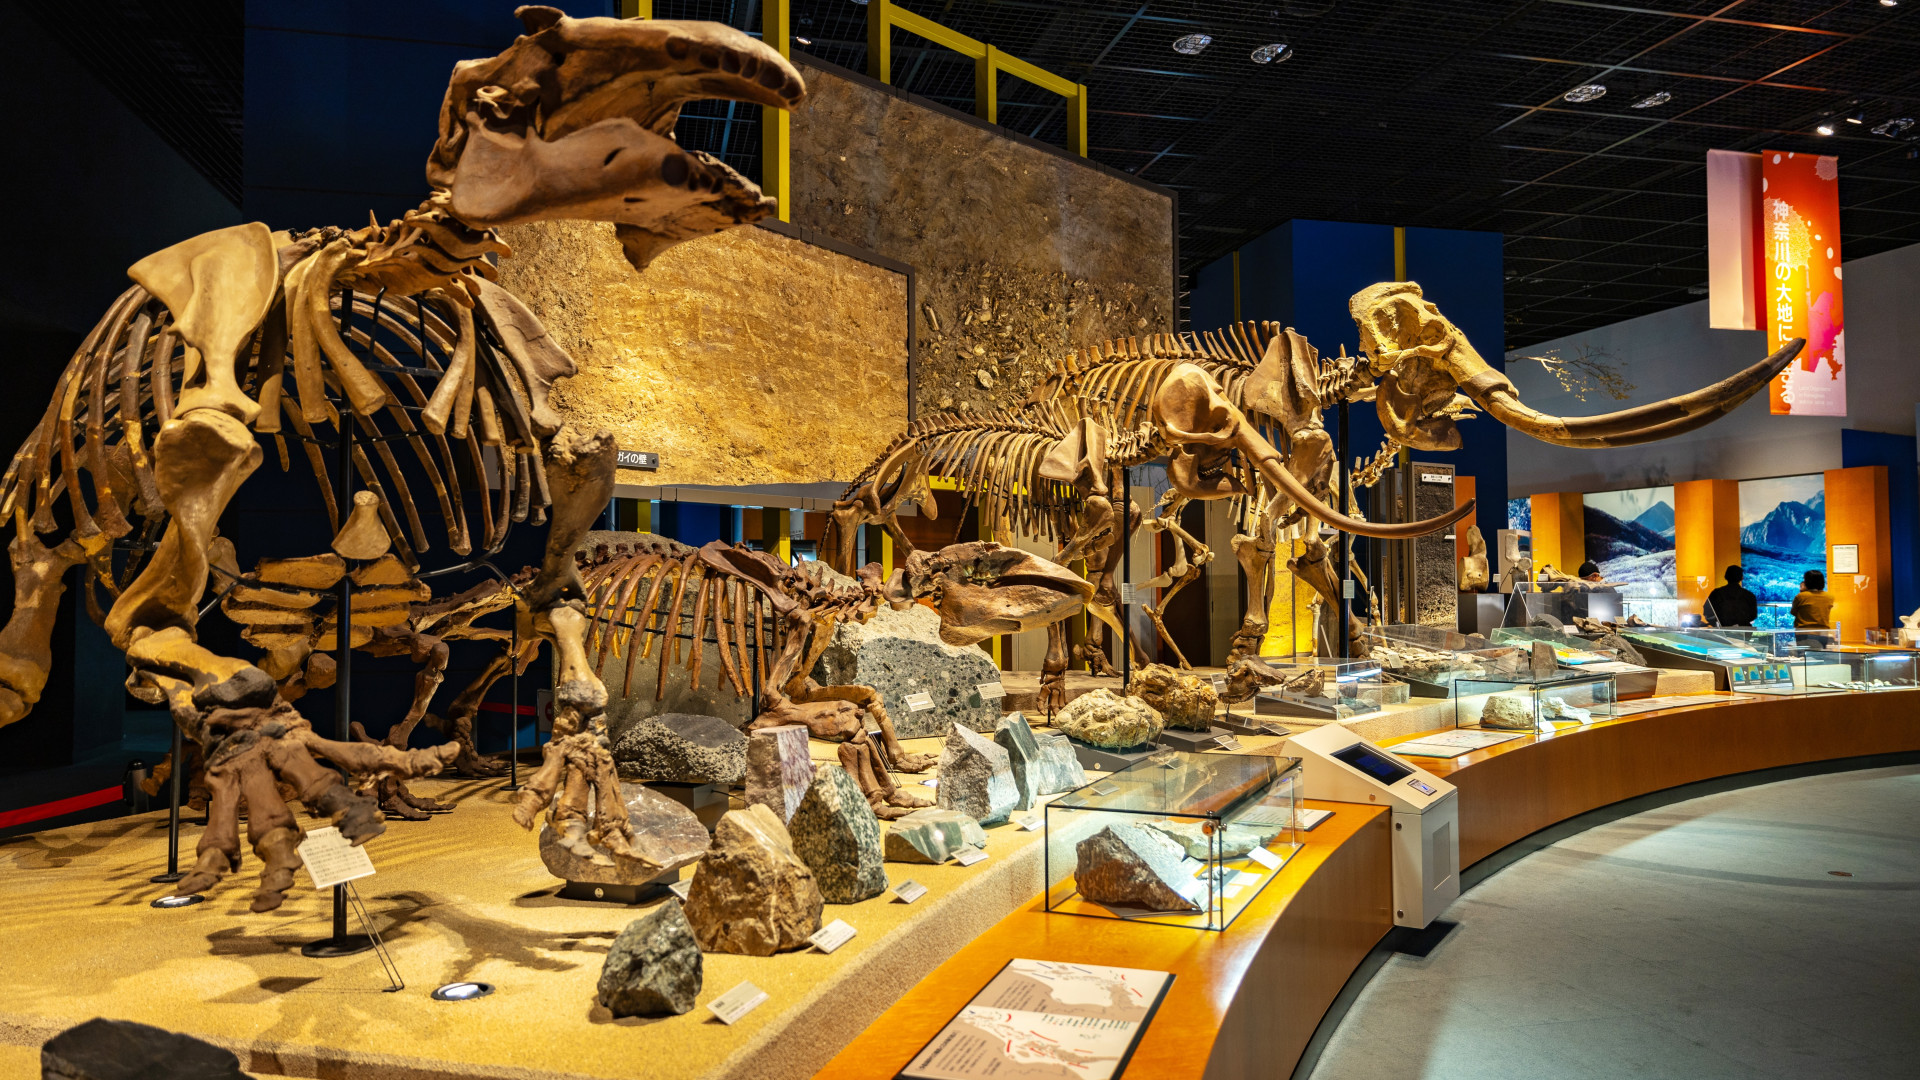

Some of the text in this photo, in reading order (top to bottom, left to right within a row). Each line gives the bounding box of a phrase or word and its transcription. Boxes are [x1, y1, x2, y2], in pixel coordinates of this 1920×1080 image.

[1773, 200, 1796, 404] 神奈川の大地にきる
[617, 451, 647, 464] ガイの壁
